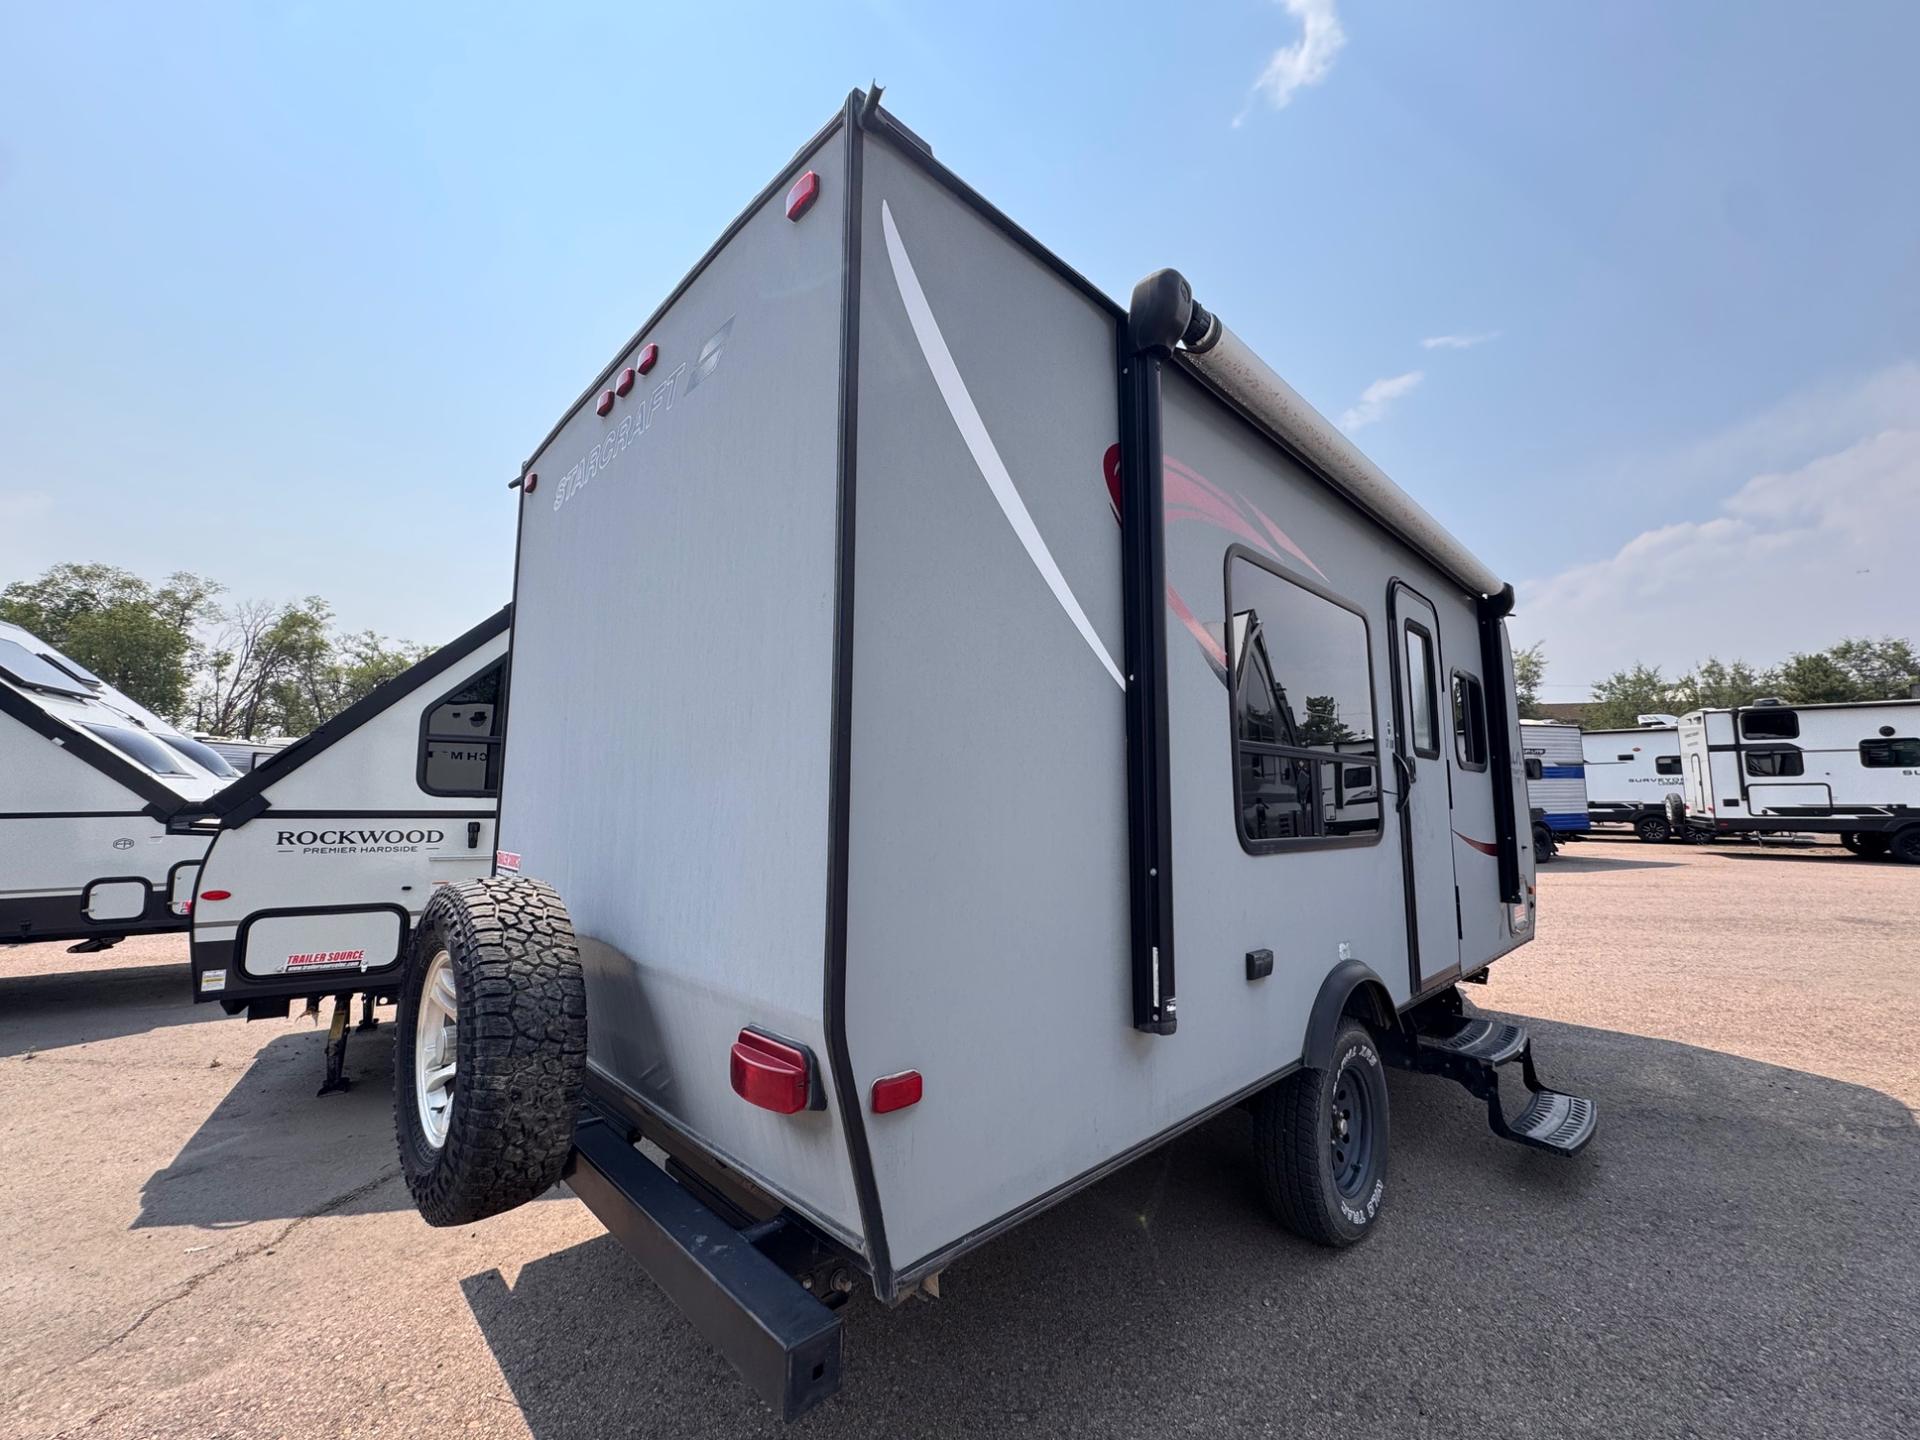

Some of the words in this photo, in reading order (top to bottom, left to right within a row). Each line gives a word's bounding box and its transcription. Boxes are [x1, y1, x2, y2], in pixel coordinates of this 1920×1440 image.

[553, 362, 687, 511] STARCRAFT
[276, 830, 444, 845] ROCKWOOD
[288, 953, 326, 964] TRAILER
[327, 950, 365, 961] SOURCE
